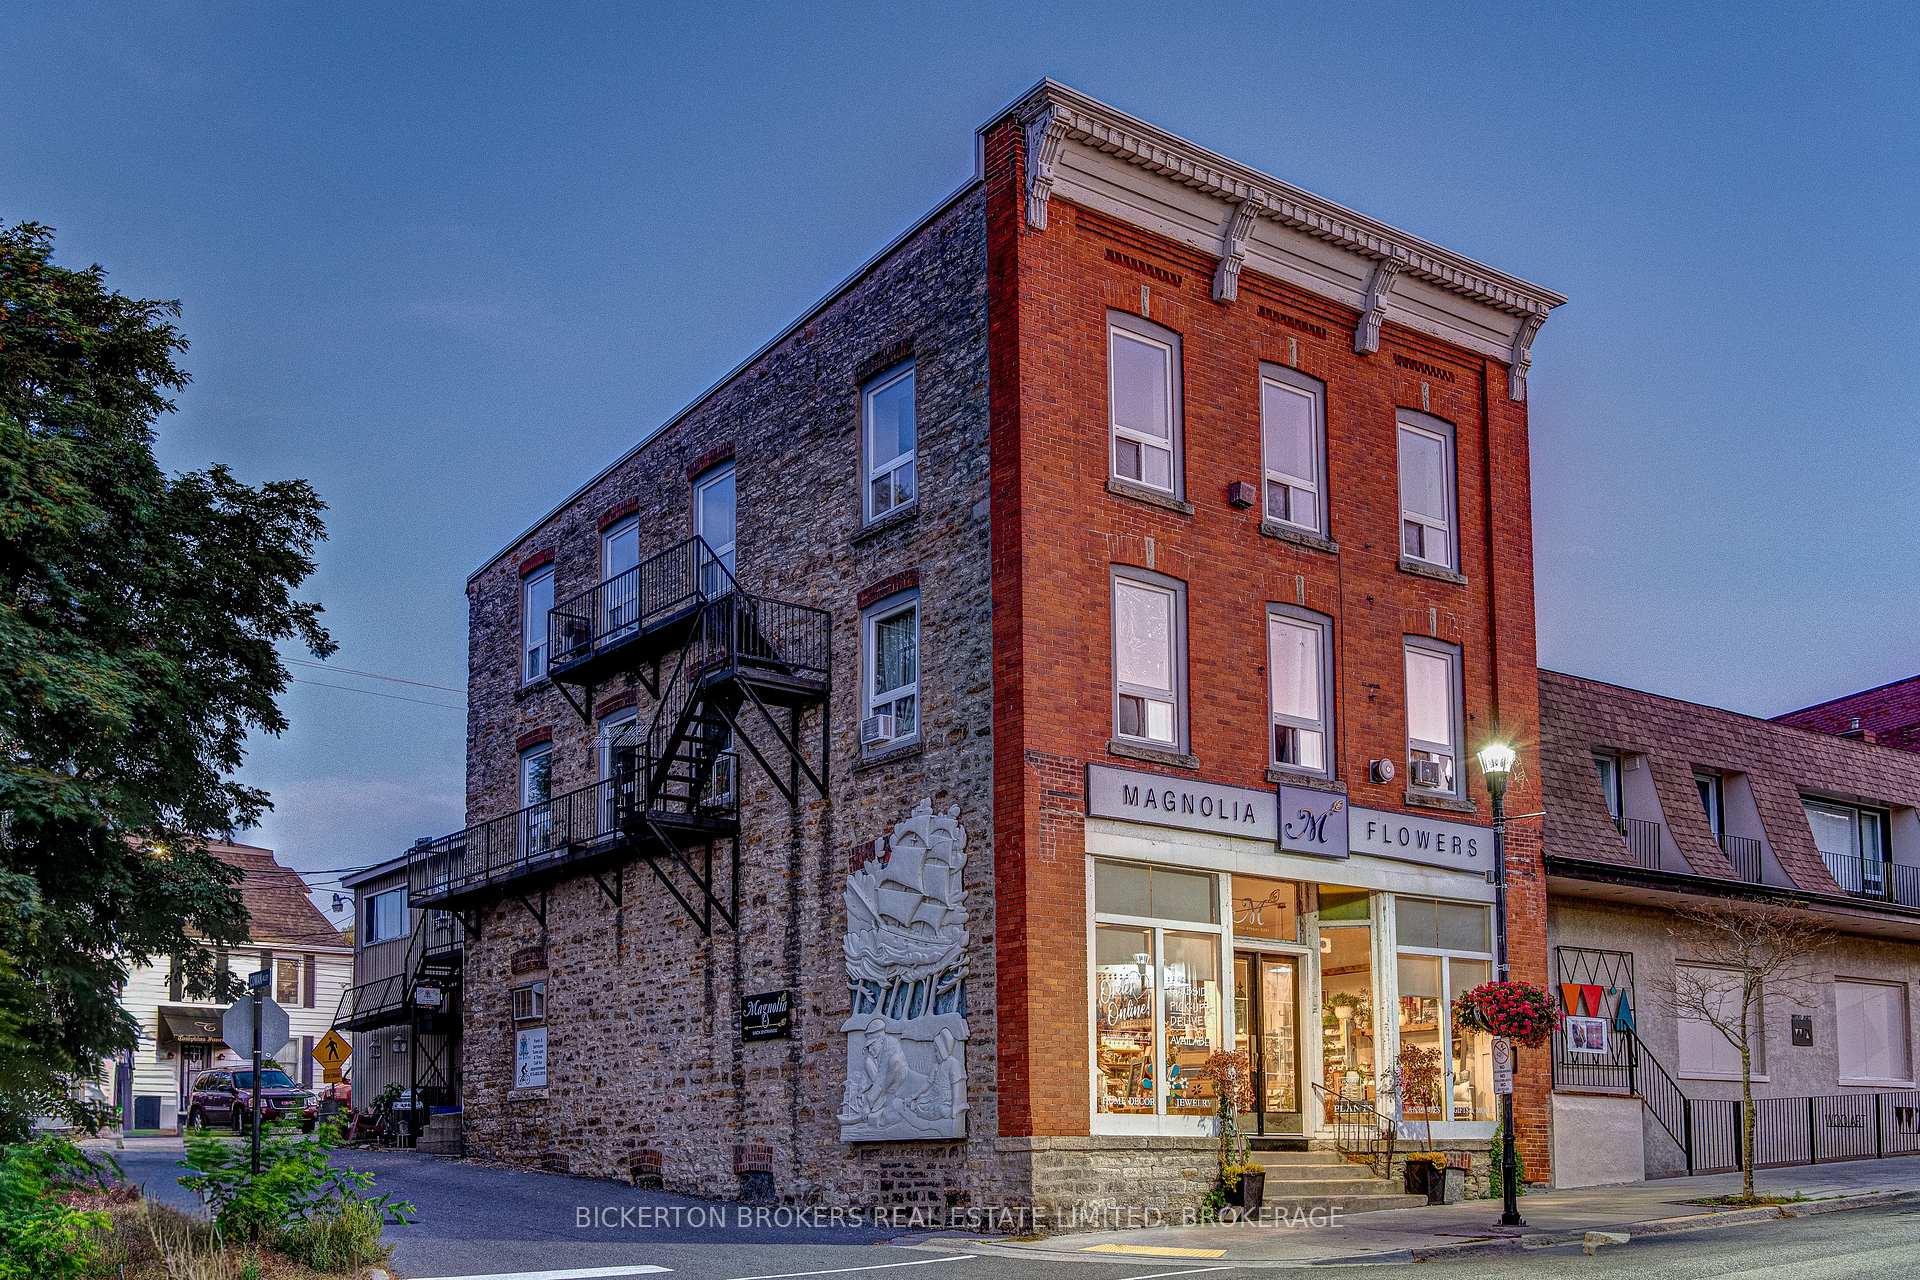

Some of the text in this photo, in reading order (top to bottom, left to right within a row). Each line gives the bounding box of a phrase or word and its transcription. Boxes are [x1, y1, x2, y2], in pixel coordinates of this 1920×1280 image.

[1122, 784, 1256, 824] MAGNOLIA
[1367, 821, 1478, 857] FLOWERS
[1107, 996, 1151, 1026] Online!
